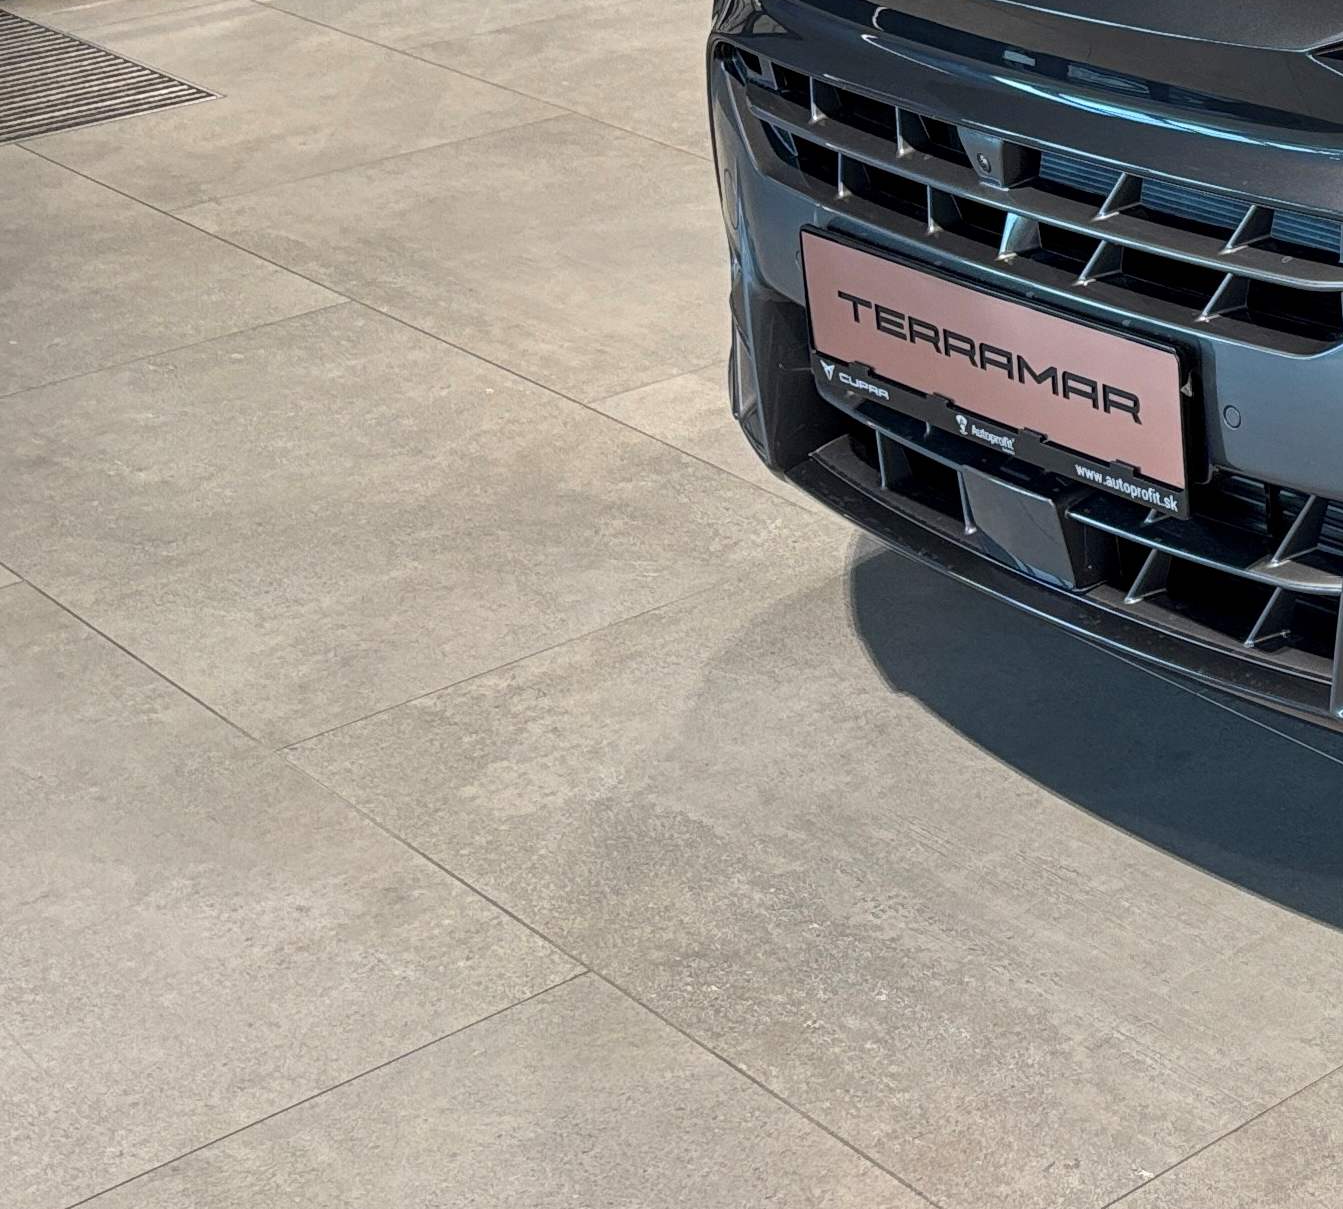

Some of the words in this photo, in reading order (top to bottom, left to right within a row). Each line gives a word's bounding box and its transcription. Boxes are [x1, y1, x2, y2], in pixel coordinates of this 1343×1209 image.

[838, 290, 1142, 424] TERRAMAR
[839, 372, 889, 400] CUPRA
[1074, 463, 1178, 513] www.autoprofit.sk
